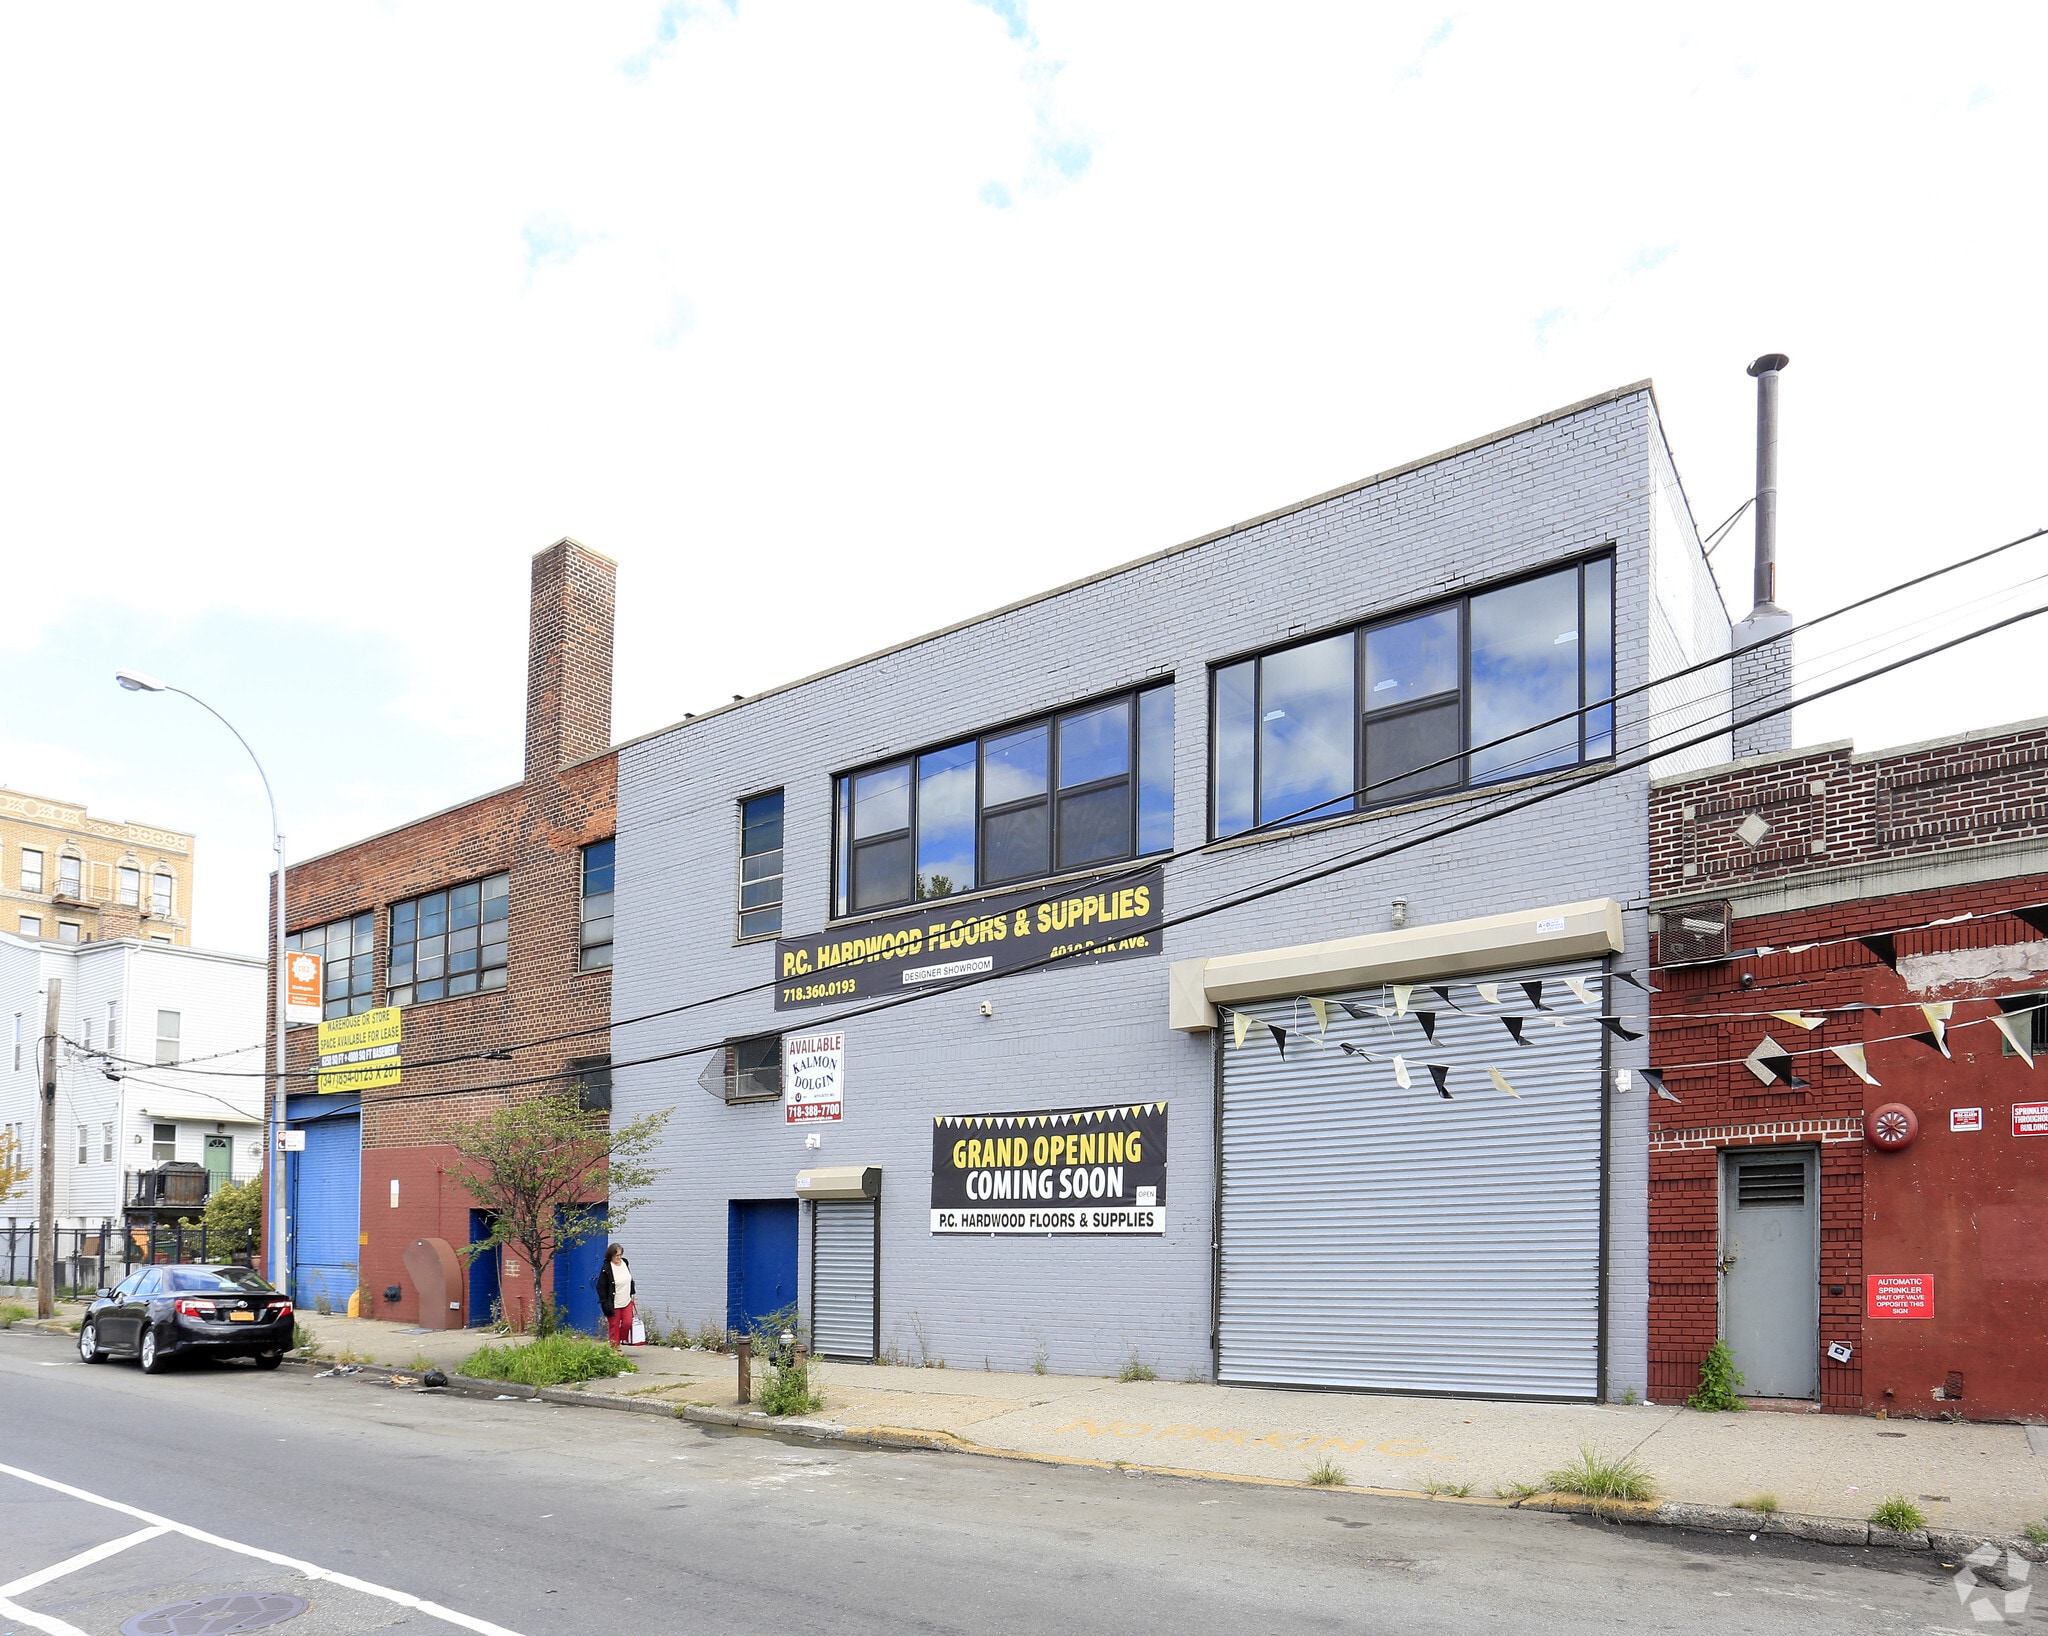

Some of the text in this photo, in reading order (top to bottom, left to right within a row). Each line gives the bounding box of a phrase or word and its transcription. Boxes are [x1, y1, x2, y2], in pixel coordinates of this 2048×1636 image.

[783, 885, 1150, 977] P.C. HARDWOOD FLOORS & SUPPLIES
[1119, 935, 1150, 951] Ave.
[904, 960, 991, 982] DESIGNER SHOWROOM
[783, 979, 856, 1003] 718.360.0193
[328, 1010, 390, 1032] WAREHOUSE OR STORE
[320, 1025, 399, 1050] SPACE AVAILABLE FOR LEASE
[789, 1036, 841, 1055] AVAILABLE
[372, 1044, 399, 1059] BASEMENT
[792, 1055, 837, 1074] KALMON
[794, 1073, 834, 1090] DOLGIN
[788, 1103, 840, 1118] 718-388-7700
[952, 1130, 1142, 1169] GRAND OPENING
[966, 1166, 1124, 1200] COMING SOON
[1138, 1190, 1155, 1198] OPEN
[939, 1212, 1154, 1228] P.C. HARDWOOD FLOORS & SUPPLIES
[1877, 1278, 1923, 1286] AUTOMATIC
[1878, 1286, 1922, 1294] SPRINKLER
[1054, 1418, 1432, 1457] NO PARKING
